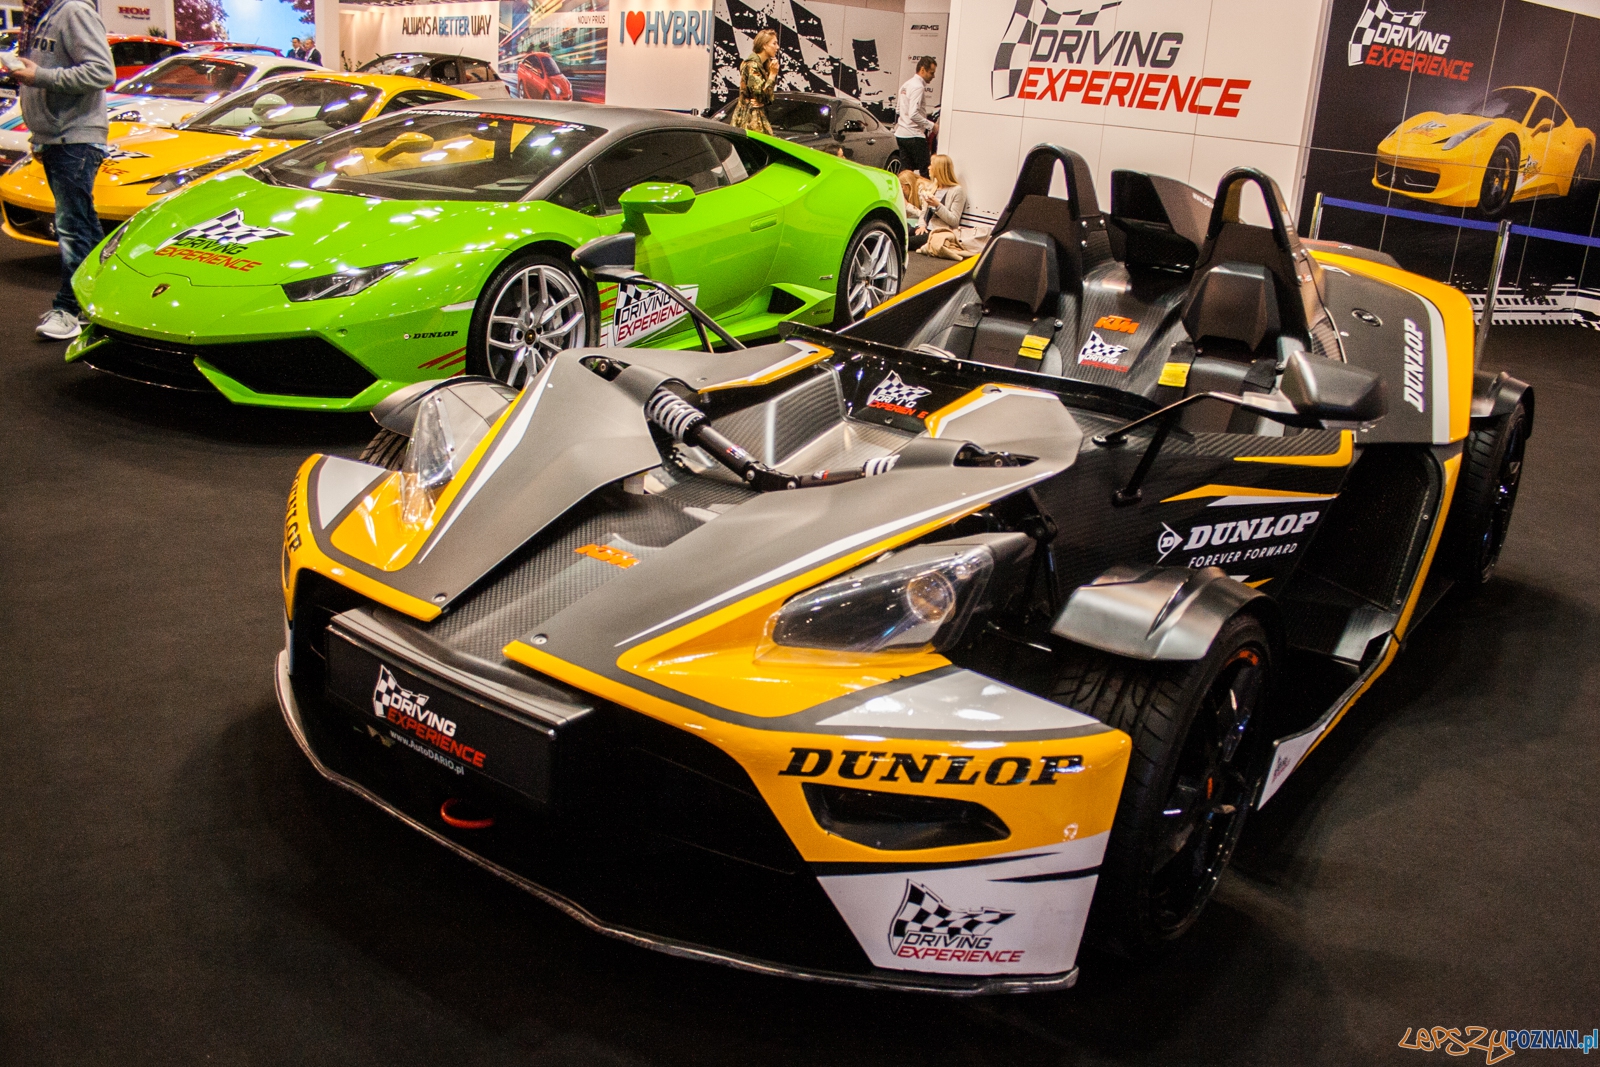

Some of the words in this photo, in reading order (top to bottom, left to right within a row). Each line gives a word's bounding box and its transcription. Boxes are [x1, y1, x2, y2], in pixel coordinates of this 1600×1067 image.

[402, 15, 432, 36] ALWAYS
[432, 16, 439, 36] A
[438, 15, 470, 36] BETTER
[471, 15, 492, 36] WAY
[577, 15, 591, 25] NOWY
[592, 15, 606, 25] PRIUS
[620, 11, 625, 44] I
[1029, 29, 1184, 69] DRIVING
[1373, 22, 1451, 55] DRIVING
[1365, 44, 1474, 81] EXPERIENCE
[1017, 67, 1252, 118] EXPERIENCE
[154, 246, 263, 272] EXPERIENCE
[173, 236, 249, 255] DRIVING
[412, 330, 459, 339] DUNLOP
[1094, 314, 1140, 334] KTM
[1403, 318, 1424, 413] DUNLOP
[869, 400, 929, 419] EXPERIENE
[1183, 511, 1320, 550] DUNLOP
[573, 543, 641, 569] KTM
[1187, 551, 1241, 568] FOREVER
[1243, 543, 1298, 560] FORWARD
[390, 692, 457, 738] DRIVING
[386, 707, 487, 768] EXPERIENCE
[389, 730, 465, 776] www.AutoDARIO.pl
[777, 747, 1085, 786] DUNLOP
[897, 946, 1026, 963] EXPERIENCE
[904, 933, 993, 949] DRIVING
